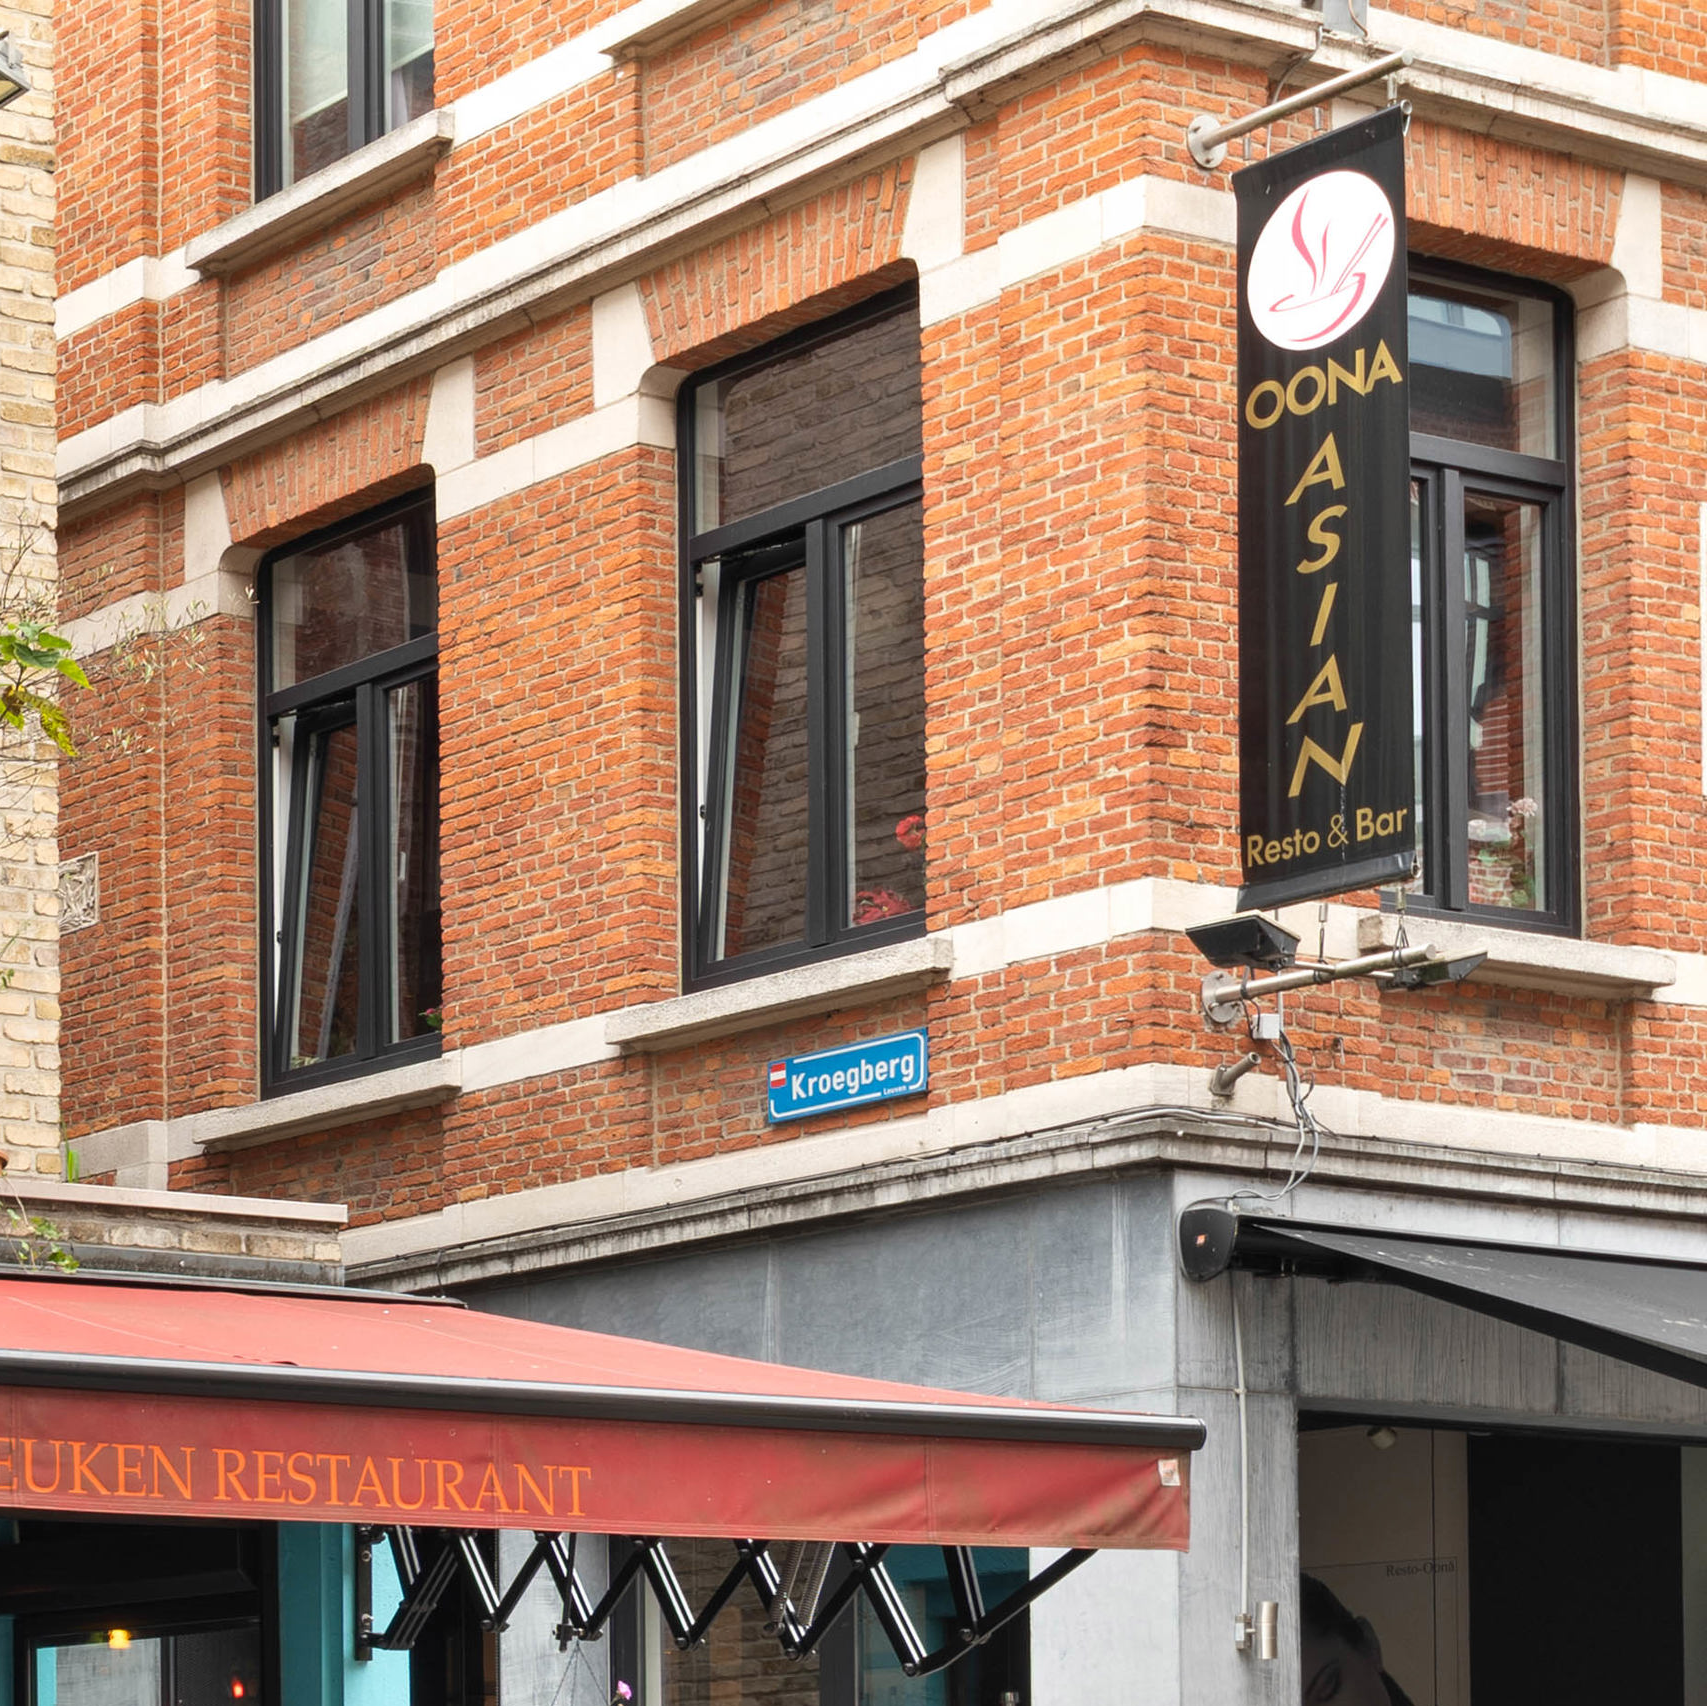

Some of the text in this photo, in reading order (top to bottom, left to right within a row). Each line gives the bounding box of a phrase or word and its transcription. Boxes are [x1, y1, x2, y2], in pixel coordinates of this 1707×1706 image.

[1245, 339, 1403, 430] OONA
[1284, 432, 1364, 798] ASIAN
[1247, 805, 1408, 868] Resto & Bar
[791, 1051, 915, 1101] Kroegberg
[212, 1447, 591, 1518] RESTAURANT
